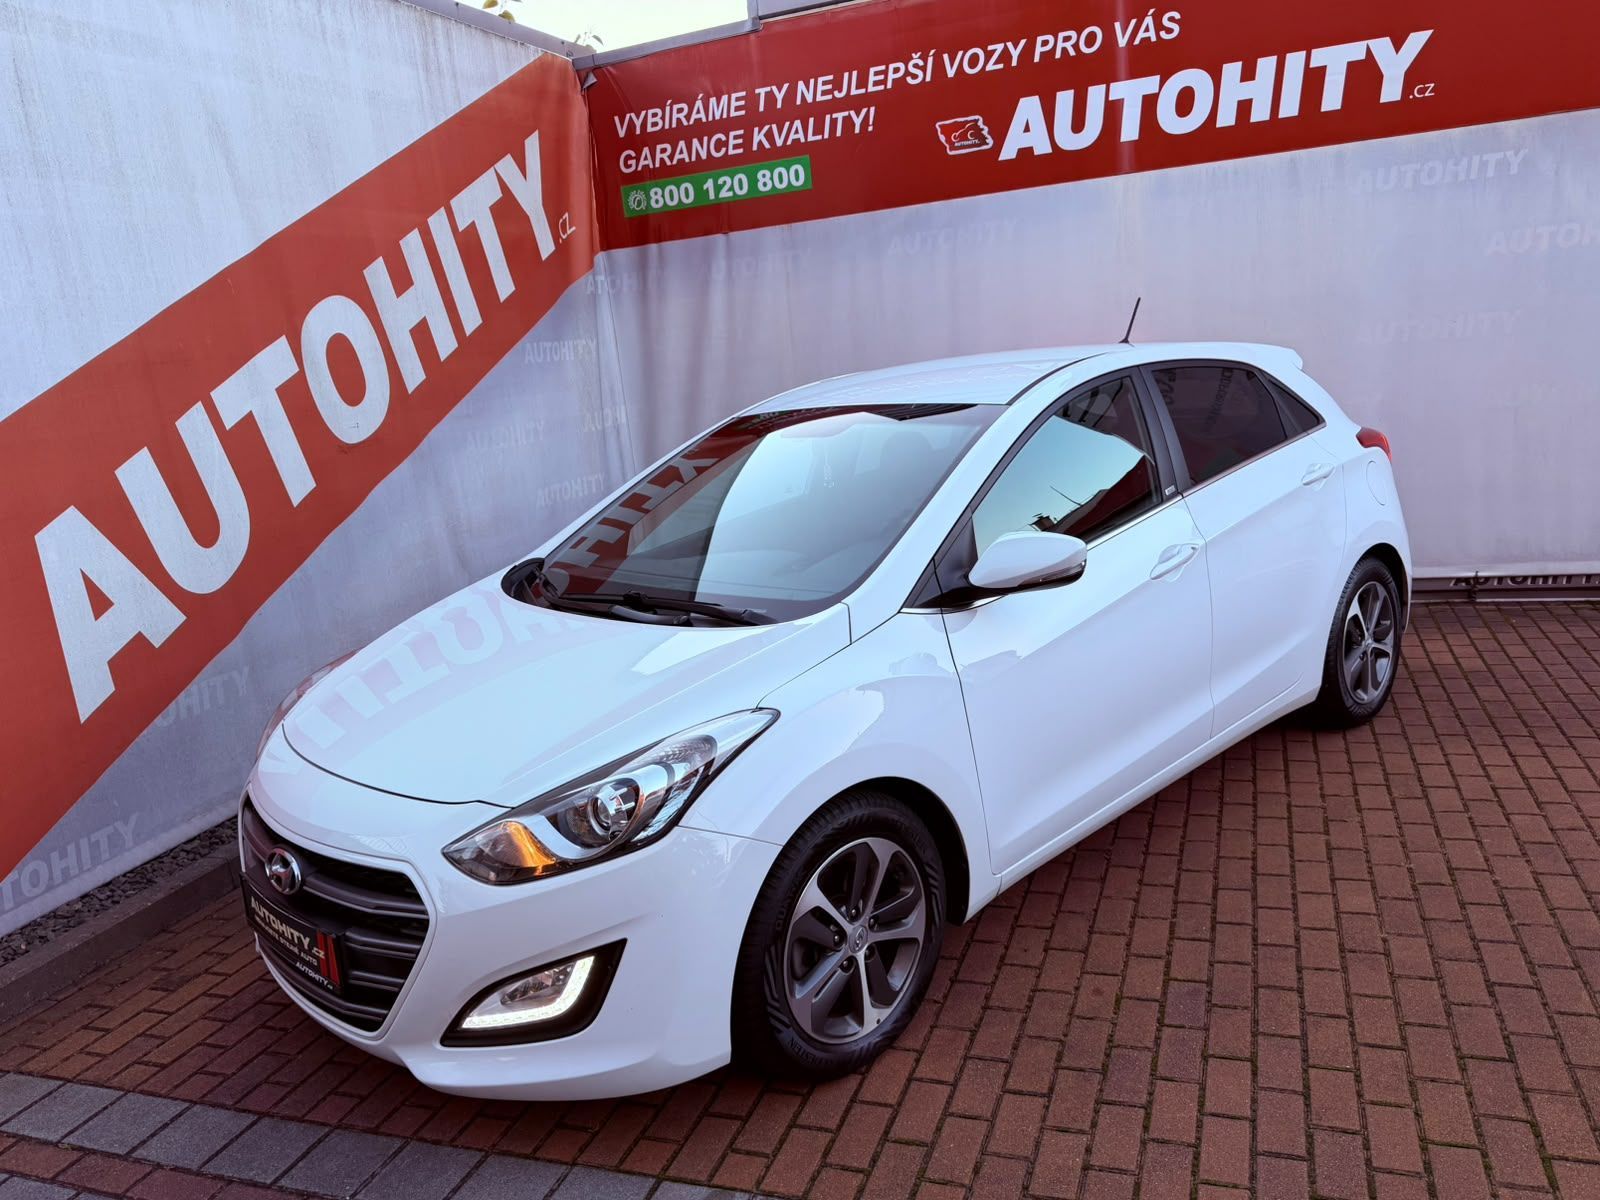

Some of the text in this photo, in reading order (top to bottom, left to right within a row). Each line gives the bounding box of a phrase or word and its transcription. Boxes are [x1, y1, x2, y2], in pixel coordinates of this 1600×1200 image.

[614, 8, 1182, 138] VYBÍRÁME TY NEJLEPŠÍ VOZY PRO VÁS
[619, 106, 876, 173] GARANCE KVALITY!
[649, 164, 805, 209] 800 120 800
[251, 895, 310, 950] AUTOHITY
